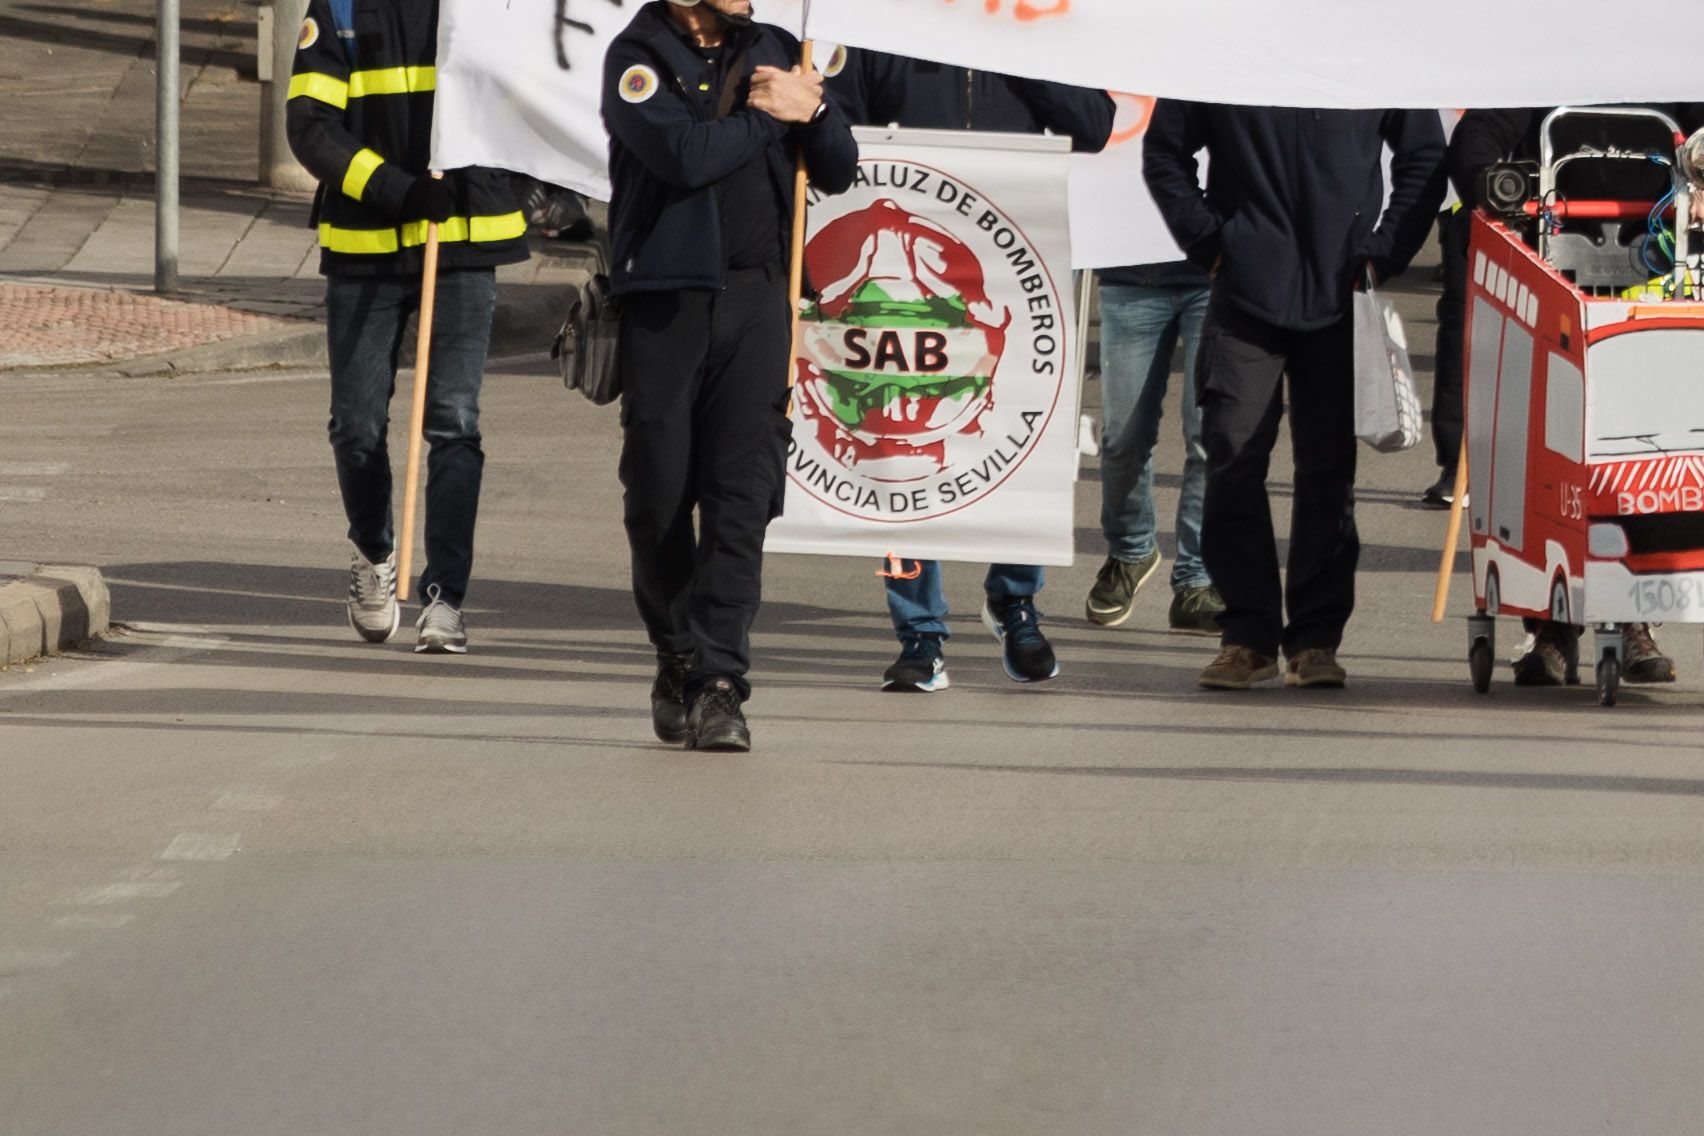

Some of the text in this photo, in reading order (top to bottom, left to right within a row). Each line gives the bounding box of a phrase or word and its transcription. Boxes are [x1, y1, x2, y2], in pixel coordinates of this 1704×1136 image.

[935, 179, 978, 219] DE
[975, 207, 1060, 377] BOMBEROS
[842, 327, 950, 375] SAB
[889, 488, 930, 513] DE
[939, 408, 1044, 505] SEVILLA
